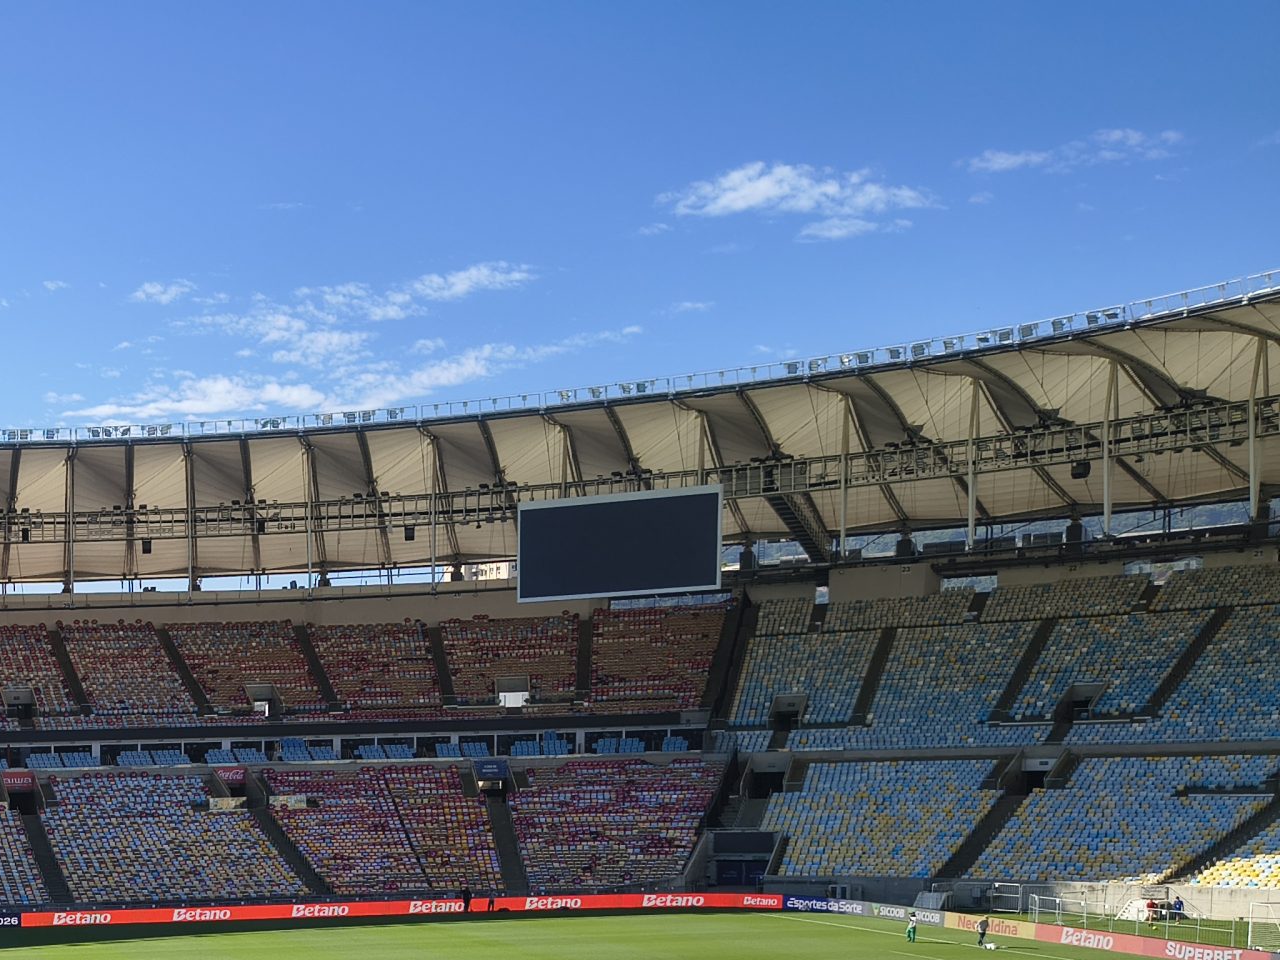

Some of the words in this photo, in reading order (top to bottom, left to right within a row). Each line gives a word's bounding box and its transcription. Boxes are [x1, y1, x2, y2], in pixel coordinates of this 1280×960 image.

[410, 901, 465, 913] Betano
[525, 897, 581, 910] Betano
[642, 894, 704, 908] Betano
[744, 896, 777, 906] Betano
[787, 898, 827, 910] Esportes
[828, 902, 838, 911] da
[838, 902, 862, 914] Sorte
[173, 908, 231, 921] Betano
[292, 904, 349, 918] Betano
[880, 907, 905, 918] SICOOB
[53, 912, 111, 925] Betano
[1061, 927, 1113, 950] Betano
